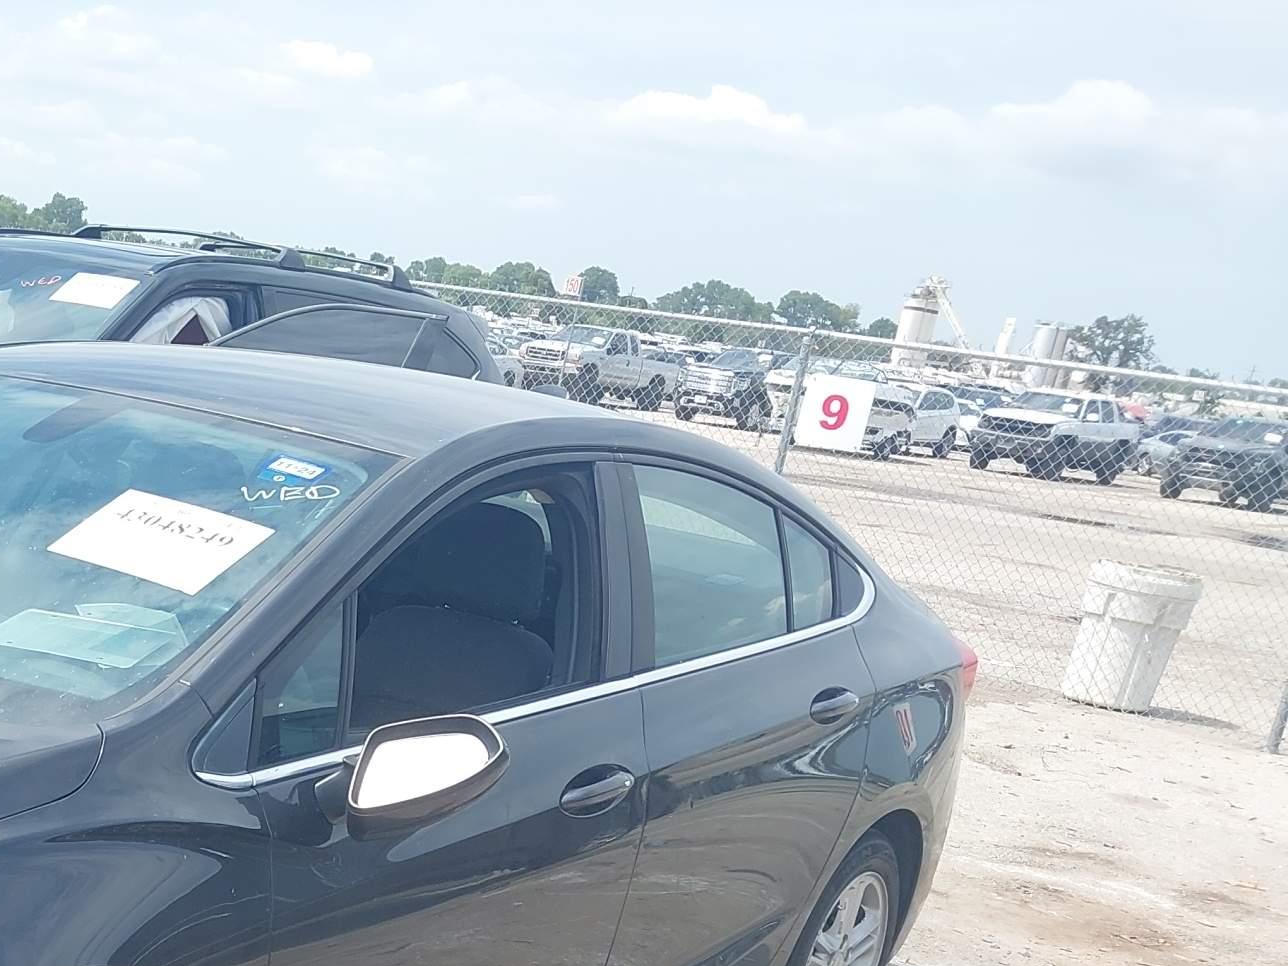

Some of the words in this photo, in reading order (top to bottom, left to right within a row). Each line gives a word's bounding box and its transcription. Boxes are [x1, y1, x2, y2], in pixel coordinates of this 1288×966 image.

[819, 394, 849, 431] 9
[240, 485, 340, 502] WED
[116, 508, 235, 546] 43048249
